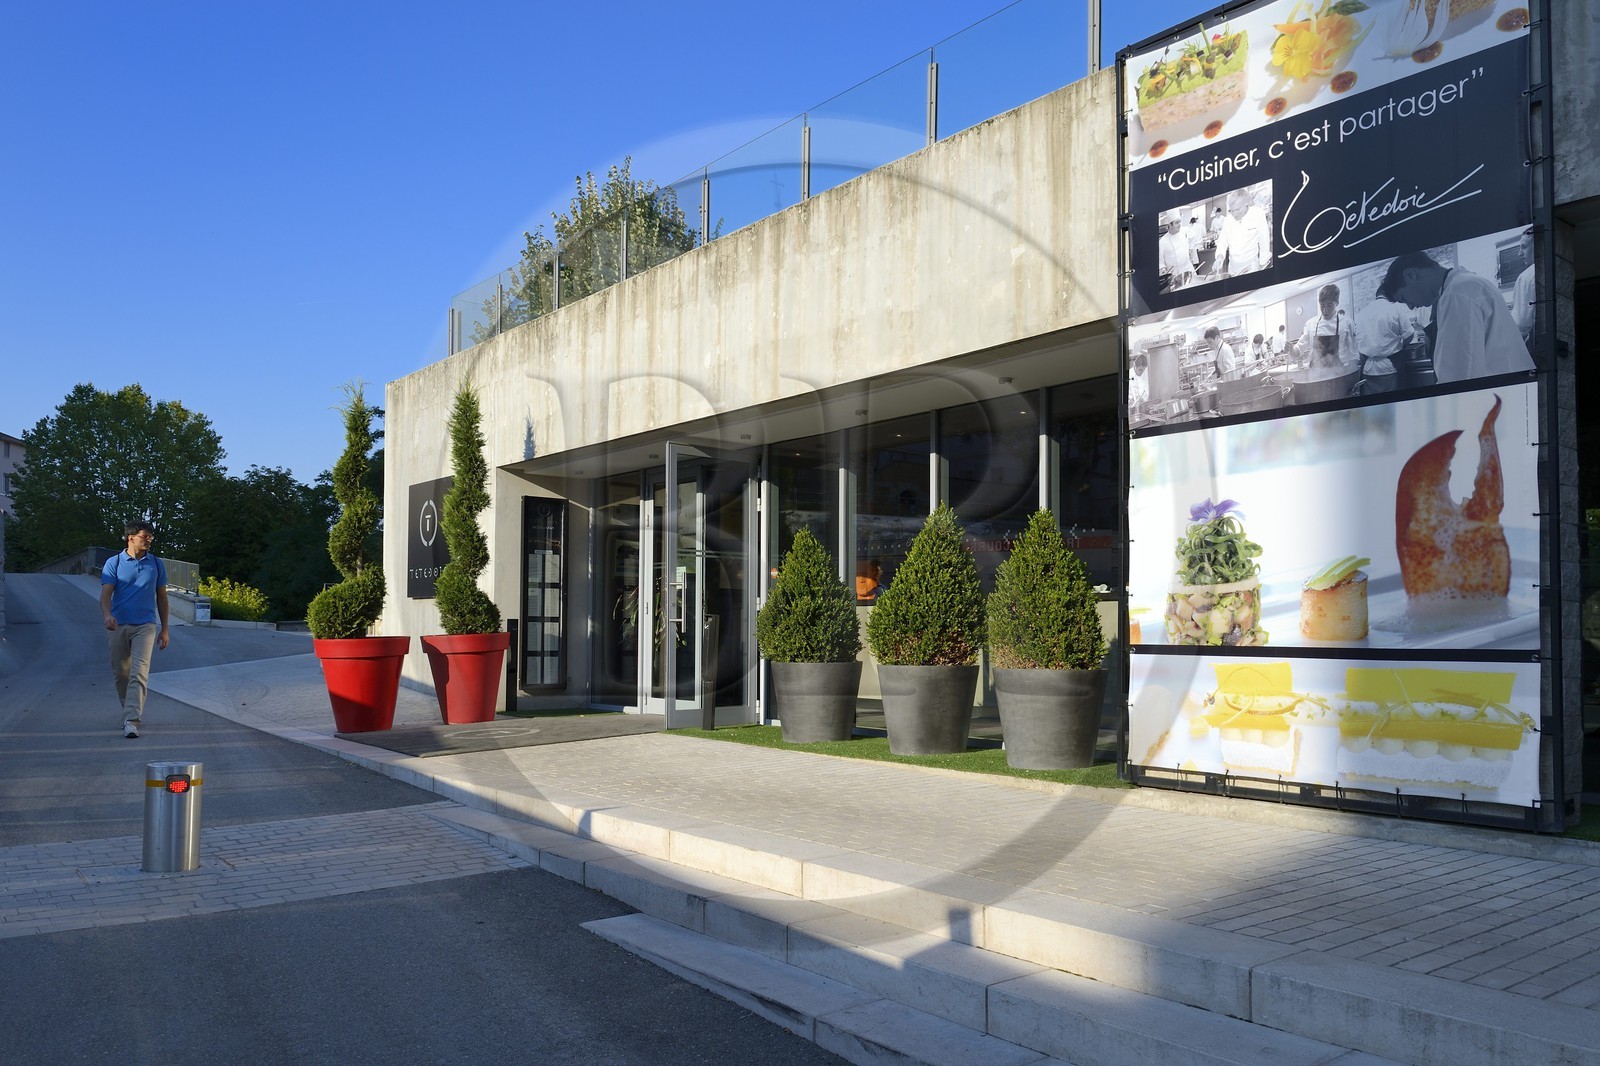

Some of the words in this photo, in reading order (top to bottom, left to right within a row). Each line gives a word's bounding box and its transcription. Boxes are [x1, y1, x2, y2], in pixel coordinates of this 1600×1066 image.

[1158, 148, 1260, 190] “Cuisiner,
[1268, 120, 1330, 158] c’est
[1340, 67, 1483, 143] partager”
